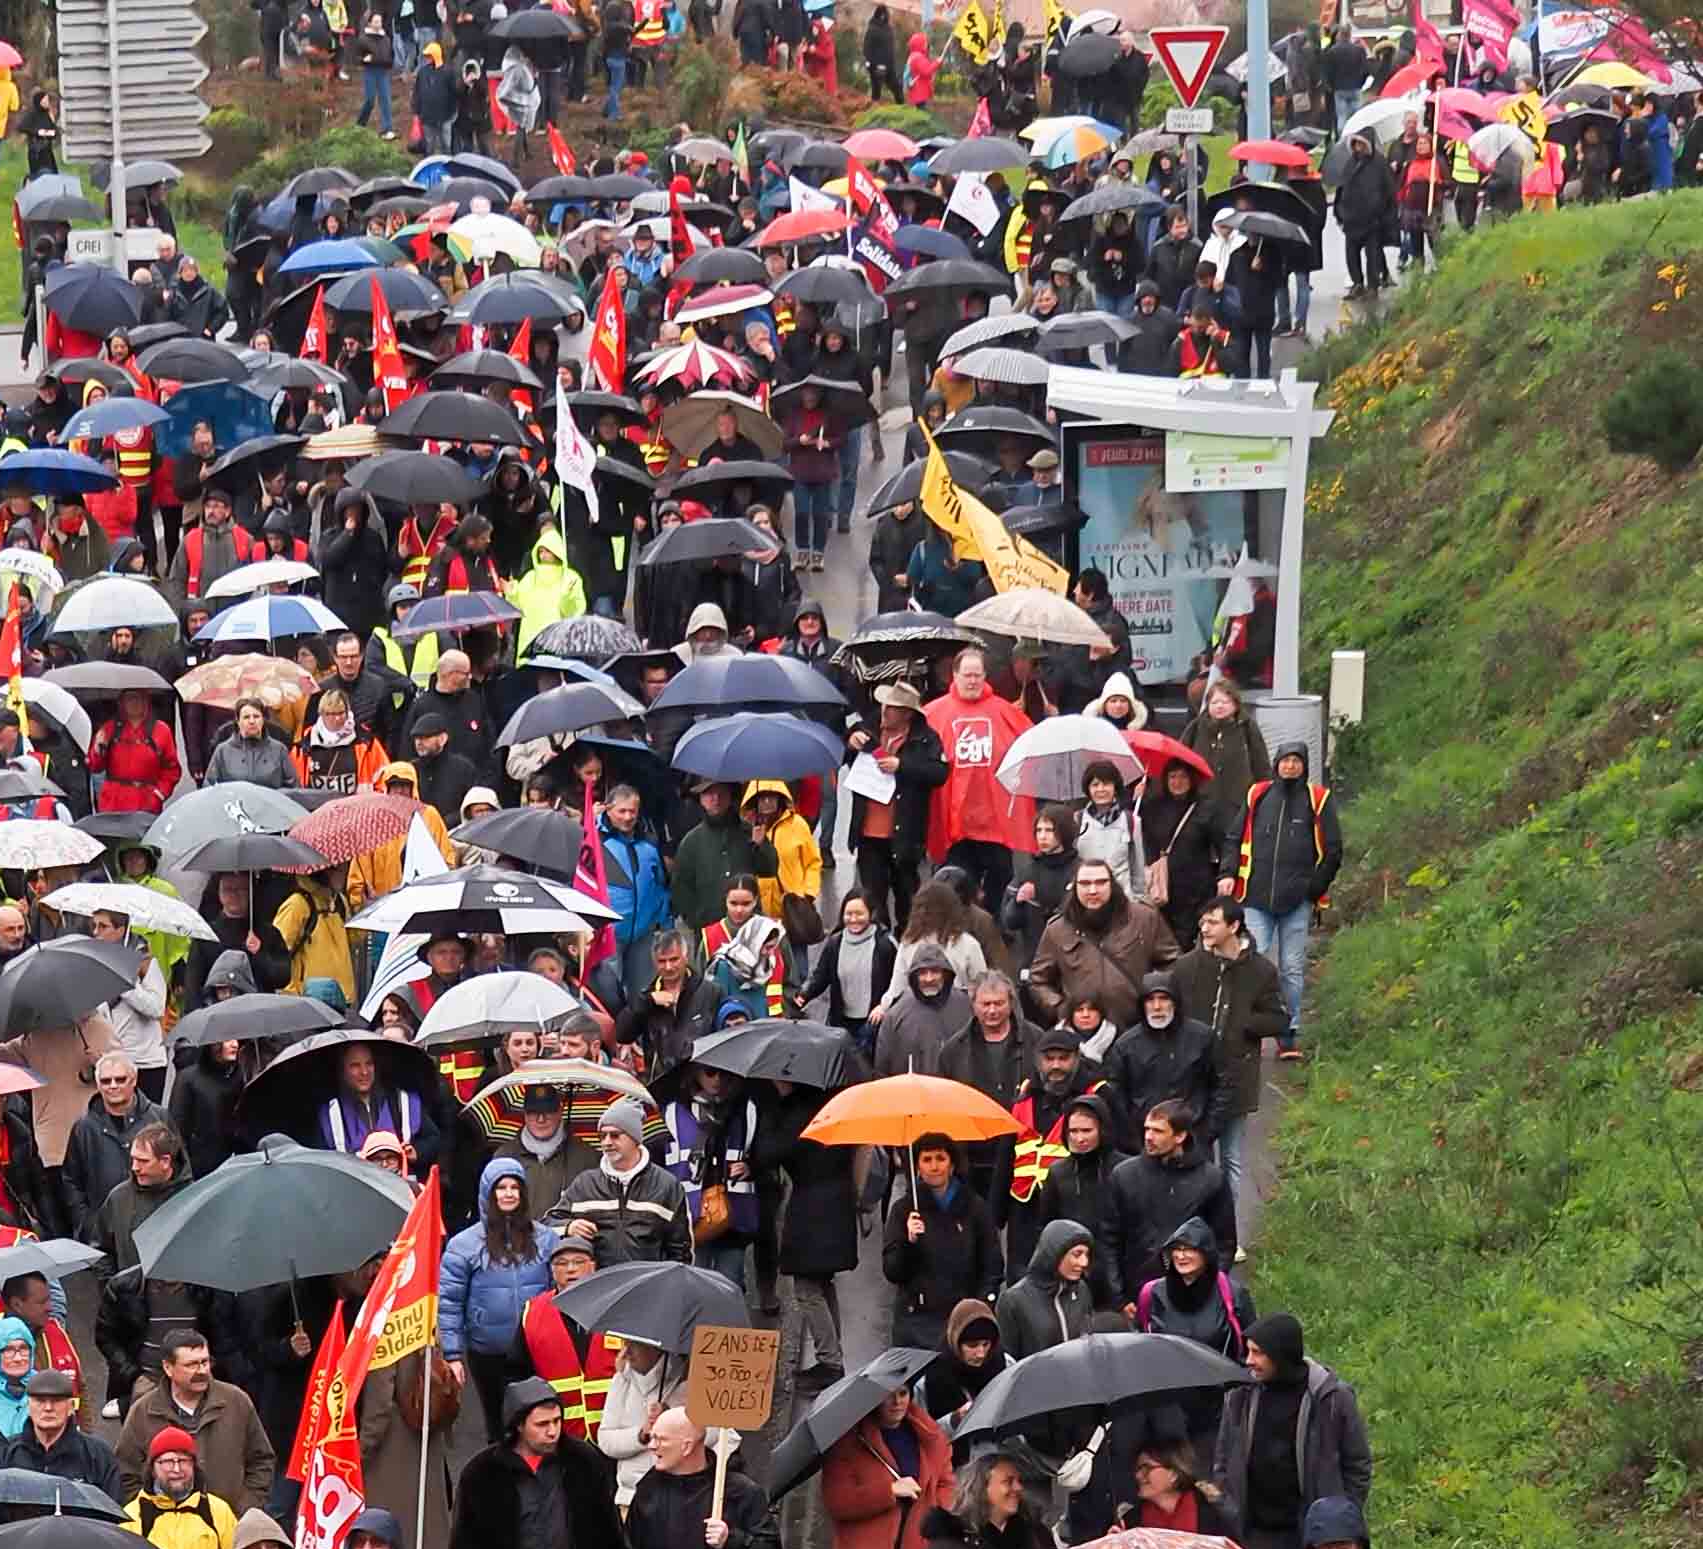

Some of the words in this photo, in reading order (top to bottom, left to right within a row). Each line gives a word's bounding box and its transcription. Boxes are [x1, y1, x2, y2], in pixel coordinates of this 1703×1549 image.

[699, 1331, 715, 1354] 2
[718, 1332, 748, 1354] ANS
[751, 1335, 764, 1353] DE
